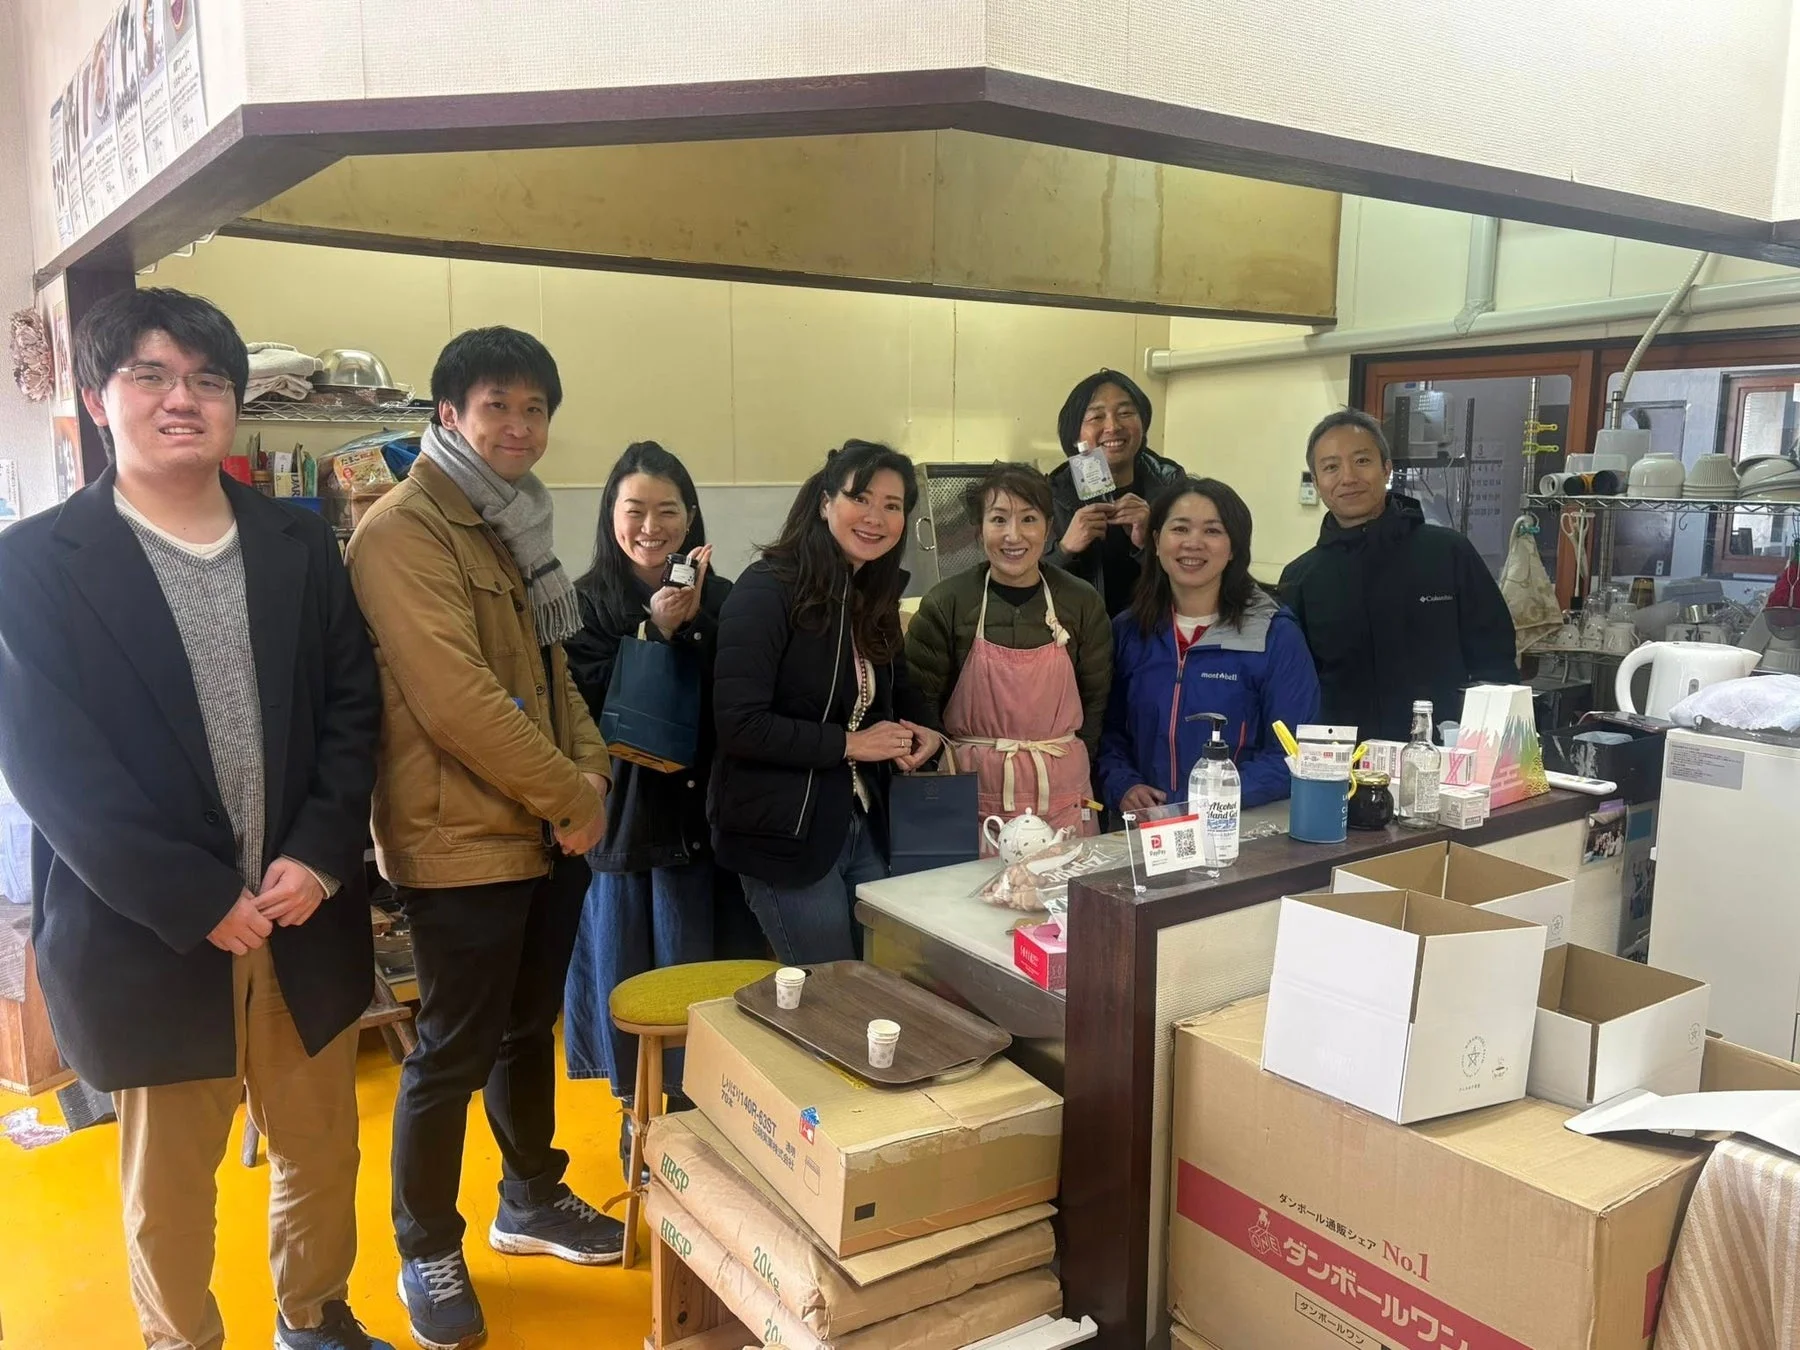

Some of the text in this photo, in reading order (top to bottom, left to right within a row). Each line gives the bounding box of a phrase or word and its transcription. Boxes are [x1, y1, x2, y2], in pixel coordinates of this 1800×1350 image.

[1279, 1193, 1431, 1283] ダンボール通販シェア No.1
[1300, 1302, 1364, 1344] ダンボールワン
